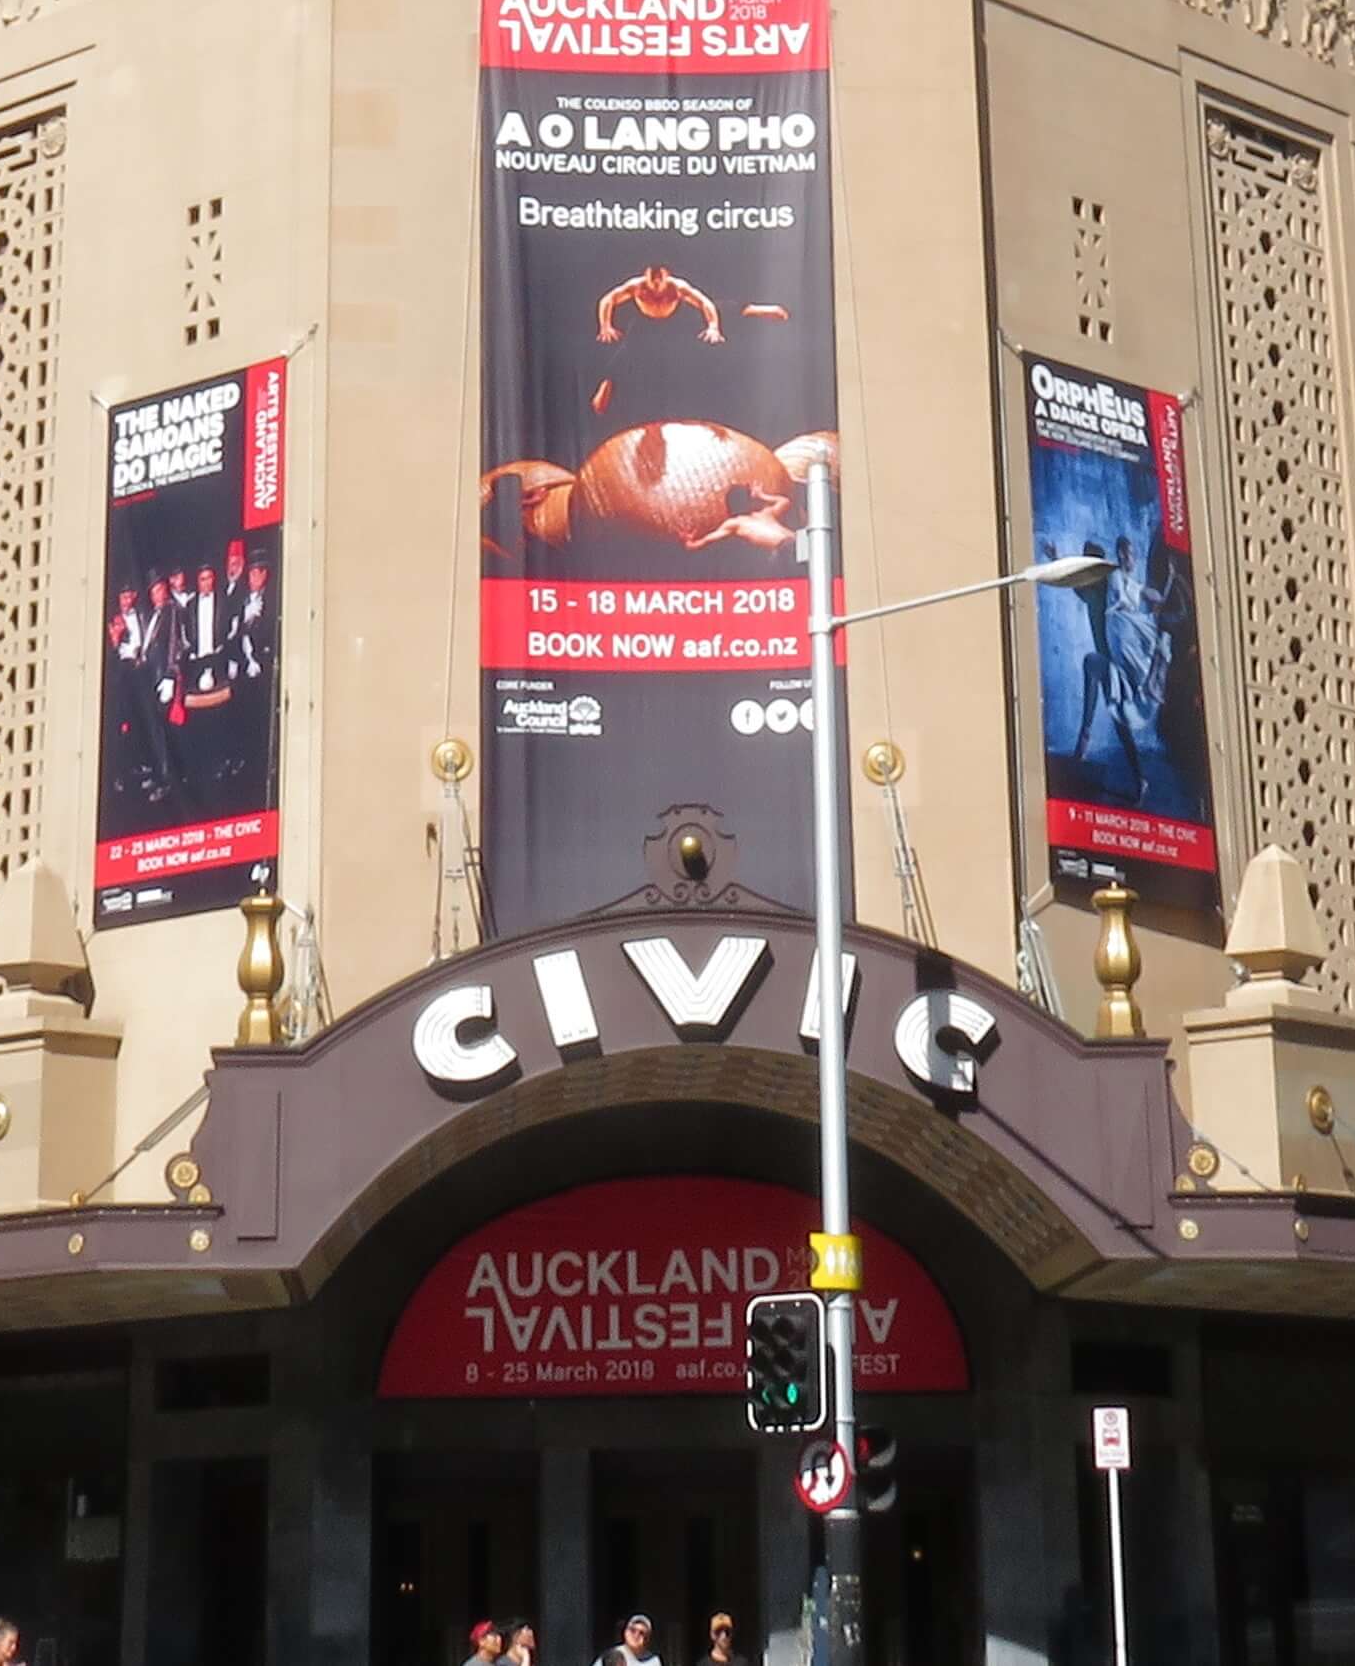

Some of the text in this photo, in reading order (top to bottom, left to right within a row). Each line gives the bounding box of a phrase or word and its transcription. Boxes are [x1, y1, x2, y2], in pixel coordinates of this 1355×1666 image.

[729, 5, 767, 21] 2018
[499, 19, 810, 57] ARTS FESTIVAL
[557, 96, 581, 110] THE
[735, 97, 753, 110] OF
[495, 112, 816, 151] A O LANG PHO
[495, 151, 816, 175] NOUVEAU CIRQUE DU VIETNAM
[519, 196, 795, 237] Breathtaking circus
[115, 404, 159, 437] THE
[162, 382, 241, 426] NAKED
[1034, 399, 1048, 418] A
[1050, 404, 1099, 432] DANCE
[1101, 418, 1149, 447] OPERA
[114, 412, 225, 463] SAMOANS
[113, 458, 145, 489] DO
[149, 438, 222, 478] MAGIC
[528, 588, 558, 613] 15
[588, 590, 617, 613] 18
[625, 590, 724, 615] MARCH
[733, 588, 796, 613] 2018
[528, 632, 798, 660] BOOK NOW aaf.co.nz
[503, 699, 568, 714] Auckland
[516, 713, 568, 728] Council
[145, 834, 181, 853] MARCH
[213, 823, 234, 840] THE
[236, 819, 261, 835] CIVIC
[137, 856, 164, 873] BOOK
[166, 850, 189, 866] NOW
[412, 936, 997, 1096] CIVIC
[466, 1247, 780, 1300] AUCKLAND
[465, 1301, 733, 1354] FESTIVAL
[465, 1362, 479, 1384] 8
[503, 1362, 530, 1384] 25
[536, 1360, 598, 1382] March
[606, 1360, 654, 1382] 2018
[675, 1358, 747, 1381] aaf.co.
